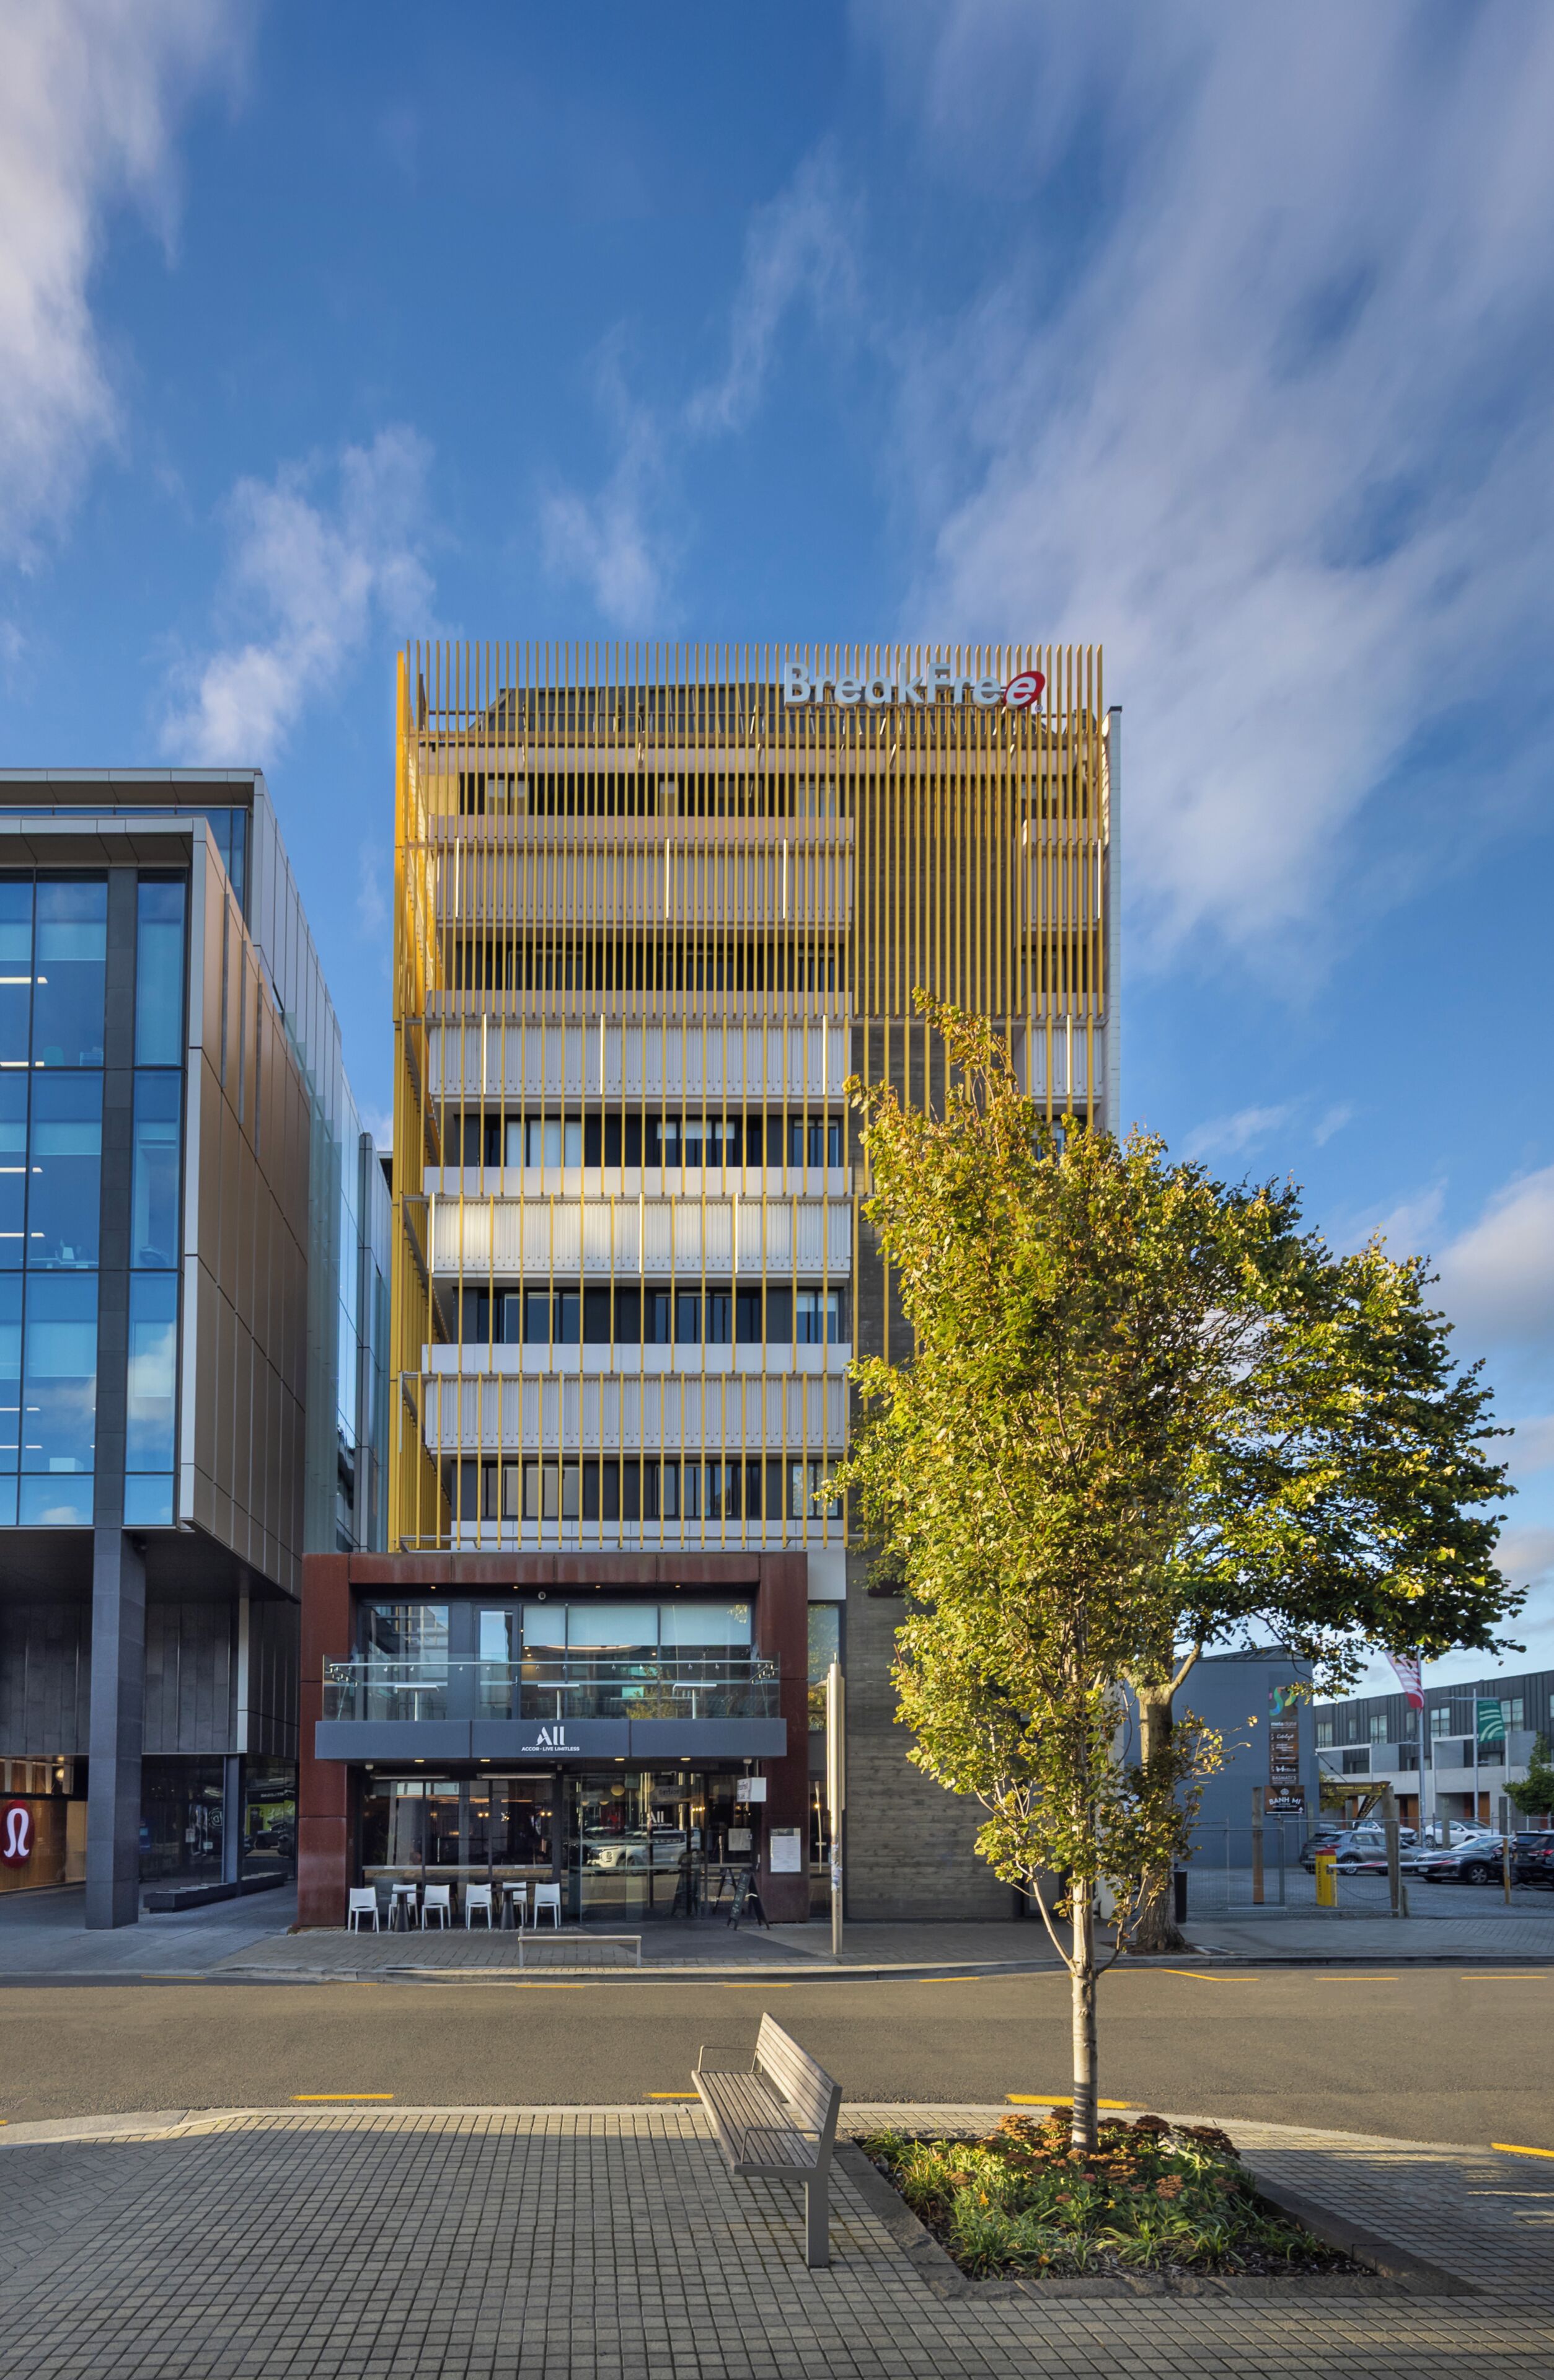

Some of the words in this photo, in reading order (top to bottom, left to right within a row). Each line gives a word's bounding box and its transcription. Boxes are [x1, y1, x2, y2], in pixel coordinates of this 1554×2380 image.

[784, 662, 1038, 709] BreakFree
[536, 1726, 565, 1746] All
[1269, 1797, 1290, 1805] BANH
